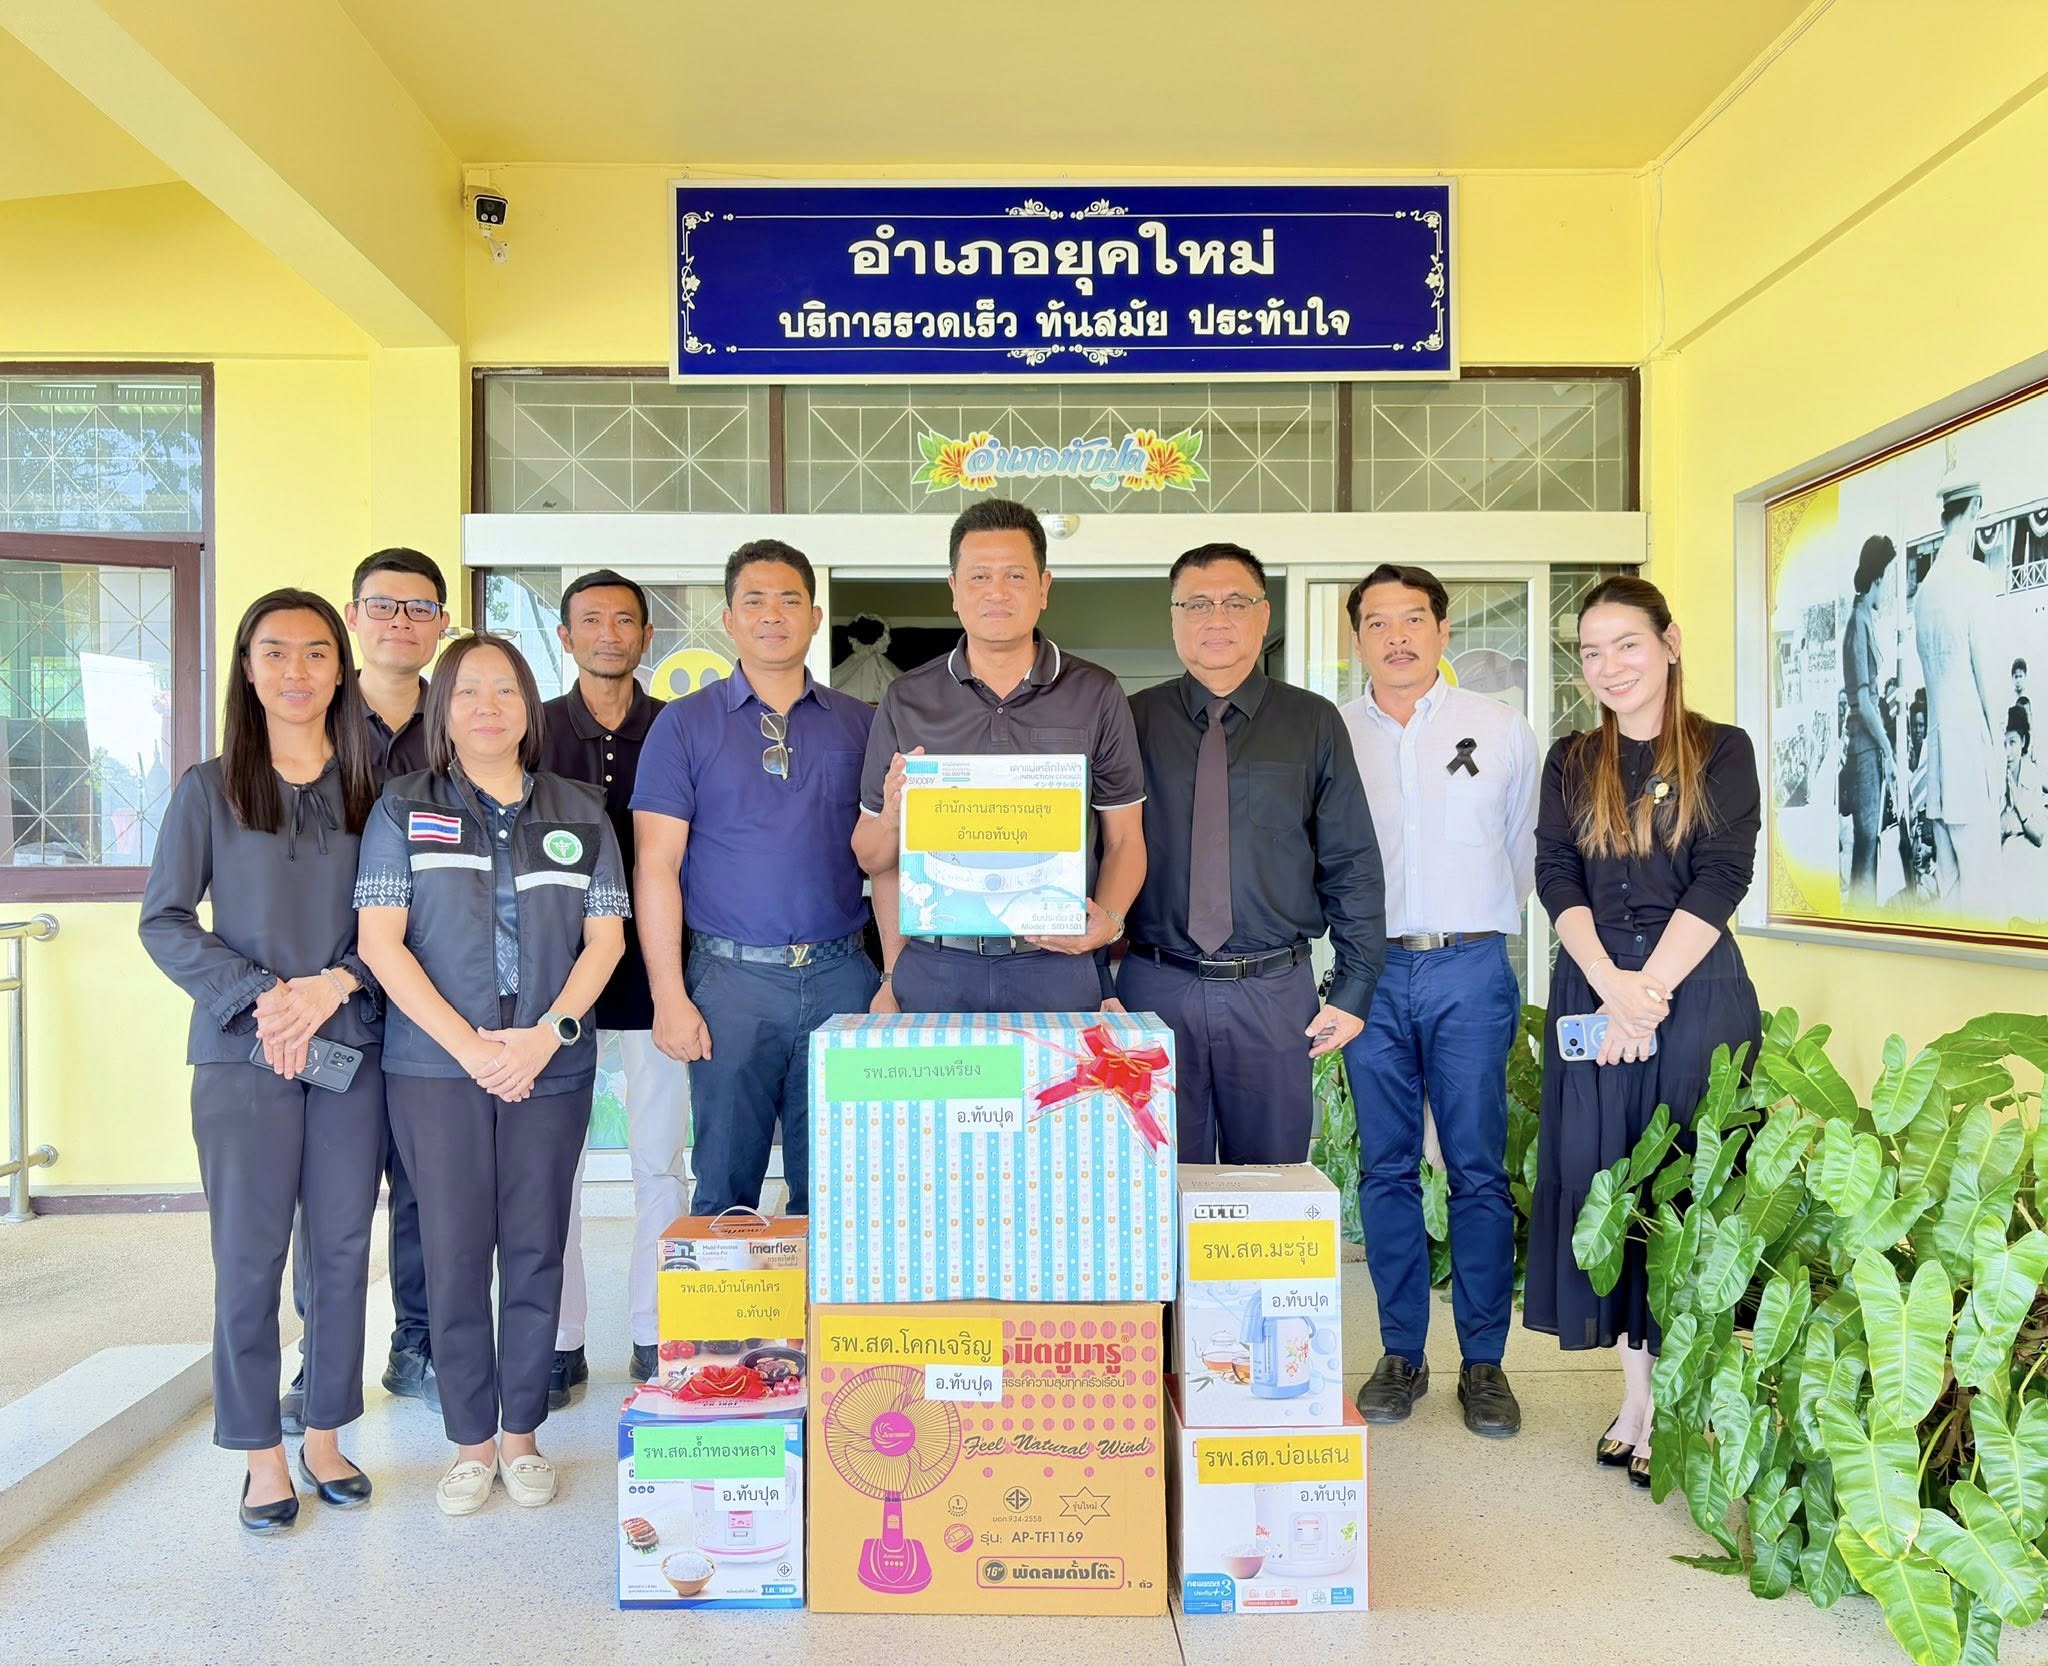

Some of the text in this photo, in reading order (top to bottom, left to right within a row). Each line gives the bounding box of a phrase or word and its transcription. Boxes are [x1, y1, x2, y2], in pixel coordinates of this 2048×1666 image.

[848, 221, 1276, 297] อำเภอยุคใหม่
[778, 296, 1351, 340] บริการรวดเร็ว ทันสมัย ประทับใจ
[964, 436, 1148, 489] อำเภอทับปุด
[908, 777, 936, 785] SNOOPY
[934, 800, 1052, 818] สำนักงานสาธารณสุข
[957, 826, 1028, 844] อำเภอทับปุด
[863, 1058, 982, 1080] รพ.สต.บางเหรียง
[957, 1105, 1015, 1128] อ.ทับปุด
[1195, 1204, 1249, 1219] OTTO
[749, 1242, 797, 1255] imarflex
[1203, 1236, 1319, 1264] รพ.สต.มะรุ่ย
[681, 1279, 780, 1294] รพ.สต.บ้านโคกไคร
[1272, 1290, 1329, 1312] อ.ทับปุด
[736, 1304, 780, 1321] อ.ทับปุด
[830, 1328, 992, 1362] รพ.สต.โคกเจริญ
[935, 1374, 993, 1396] อ.ทับปุด
[644, 1436, 776, 1459] รพ.สต.ถ้ำทองหลาง
[964, 1434, 1149, 1456] Feel Natural Wind
[1205, 1443, 1349, 1467] รพ.สต.บ่อแสน
[722, 1484, 779, 1505] อ.ทับปุด
[1300, 1484, 1356, 1506] อ.ทับปุด
[1072, 1502, 1098, 1512] รุ่นใหม่
[992, 1515, 1042, 1523] มอก.934-2558
[1011, 1531, 1084, 1543] AP-TF1169
[1012, 1560, 1116, 1580] พัดลมตั้งโต๊ะ
[1127, 1580, 1153, 1589] 1 ตัว
